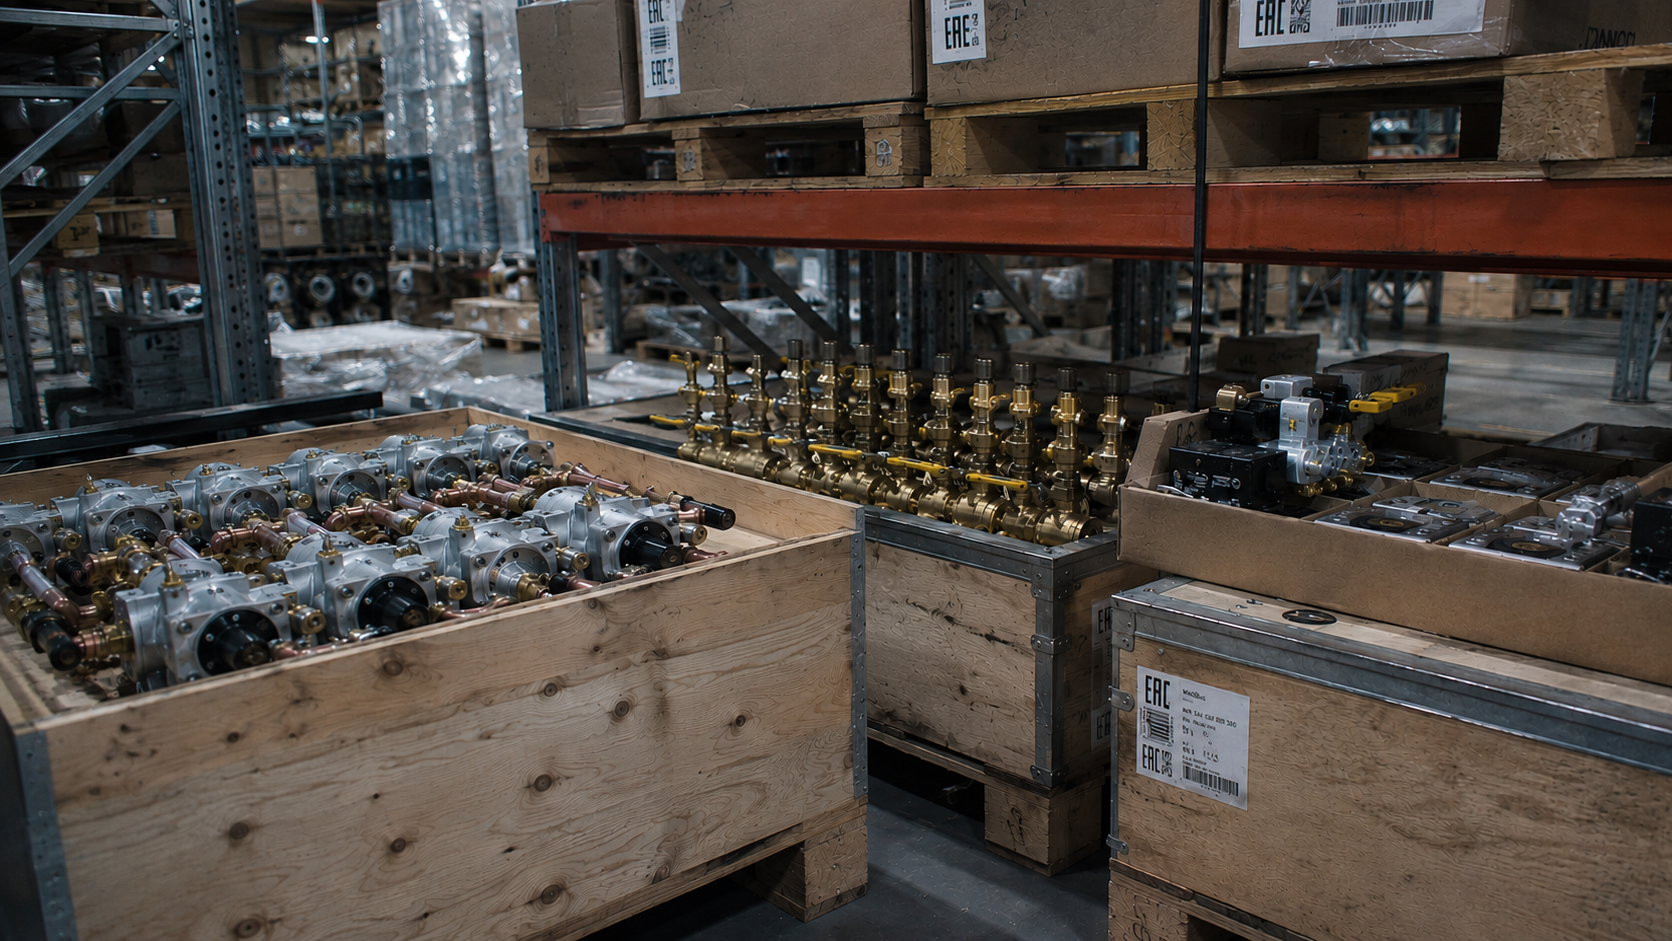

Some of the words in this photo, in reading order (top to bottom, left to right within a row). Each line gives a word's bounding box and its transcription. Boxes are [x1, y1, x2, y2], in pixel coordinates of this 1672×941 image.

[1255, 0, 1285, 37] EAC
[651, 58, 668, 86] EAC
[1145, 674, 1171, 710] EAC
[1142, 743, 1161, 774] EAC
